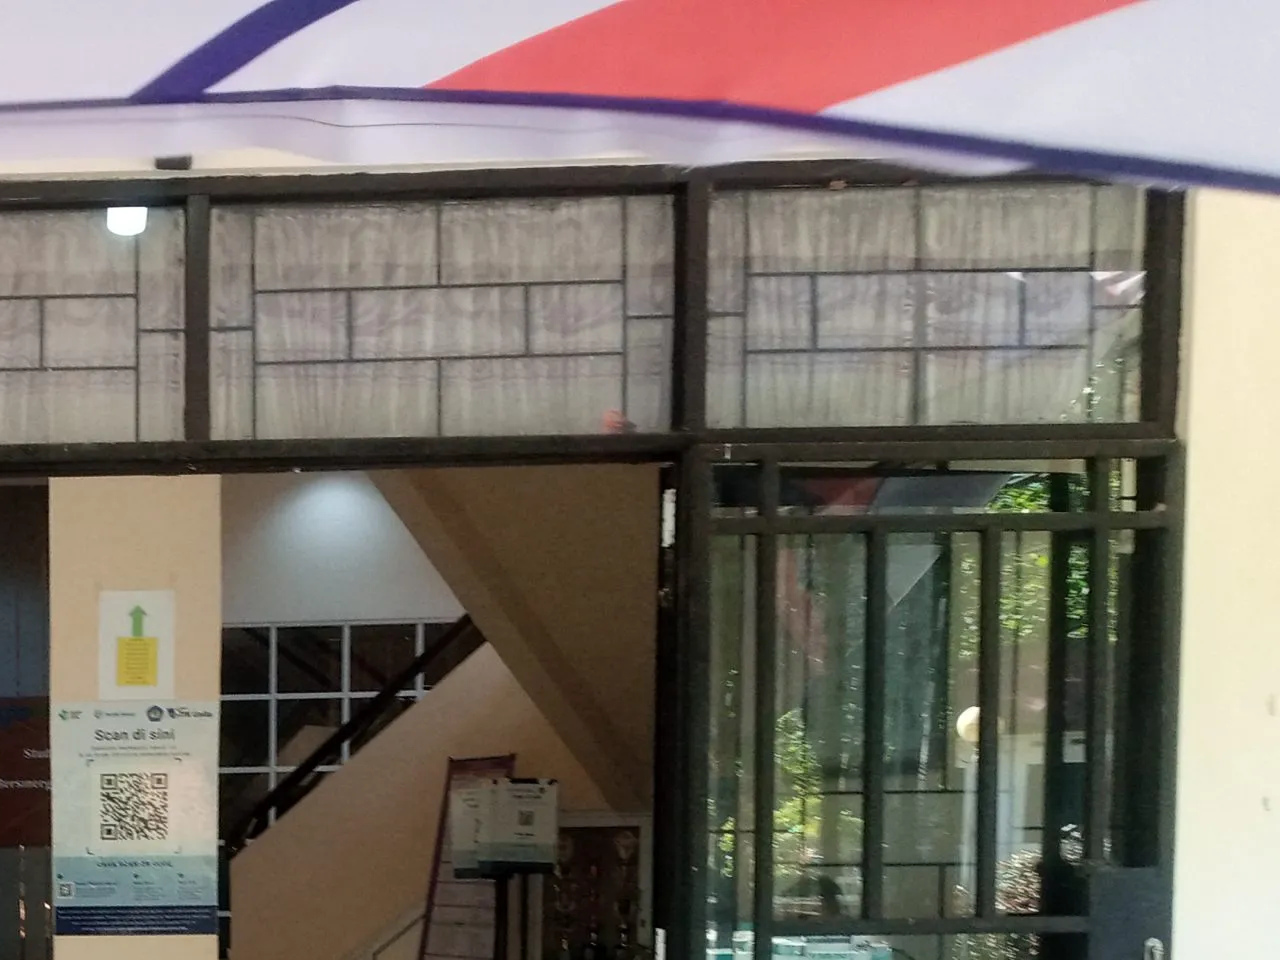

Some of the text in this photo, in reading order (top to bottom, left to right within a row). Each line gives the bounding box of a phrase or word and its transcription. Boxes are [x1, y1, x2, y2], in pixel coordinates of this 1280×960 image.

[94, 727, 176, 742] Scan di sini
